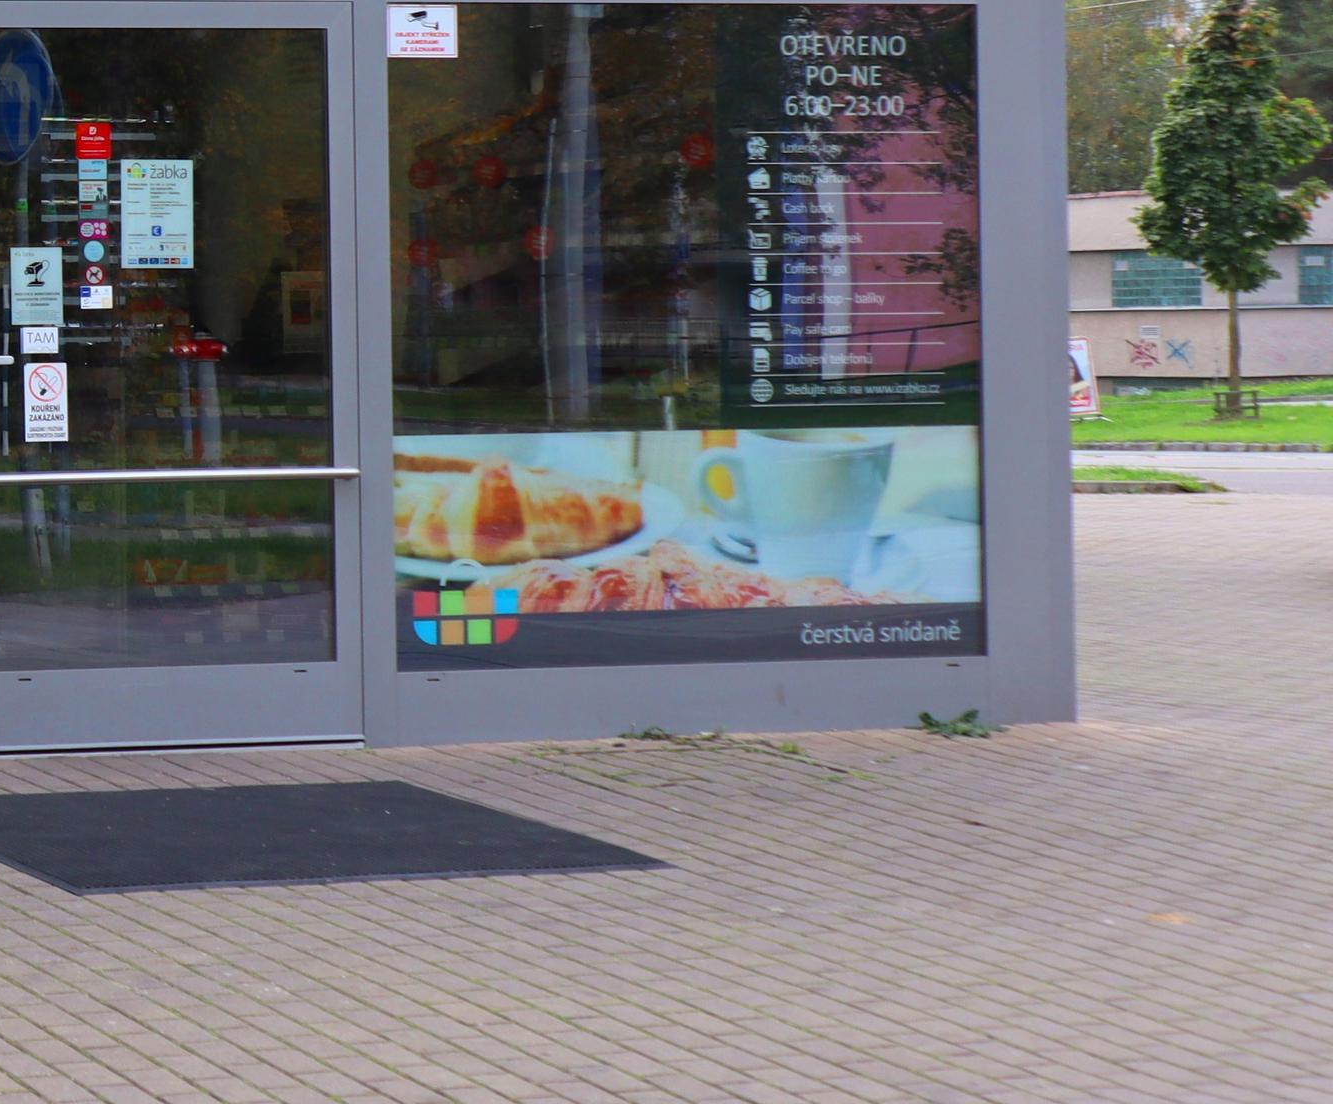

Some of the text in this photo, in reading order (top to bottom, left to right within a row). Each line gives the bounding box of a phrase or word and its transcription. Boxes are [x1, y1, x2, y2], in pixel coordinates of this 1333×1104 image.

[779, 28, 907, 56] OTEVŘENO
[805, 64, 883, 86] PO–NE
[785, 95, 905, 116] 6:00–23:00
[150, 163, 188, 179] žabka
[782, 202, 807, 215] Cash
[783, 292, 816, 305] Parcel
[26, 331, 56, 344] TAM
[801, 618, 961, 645] čerstvá snídaně
